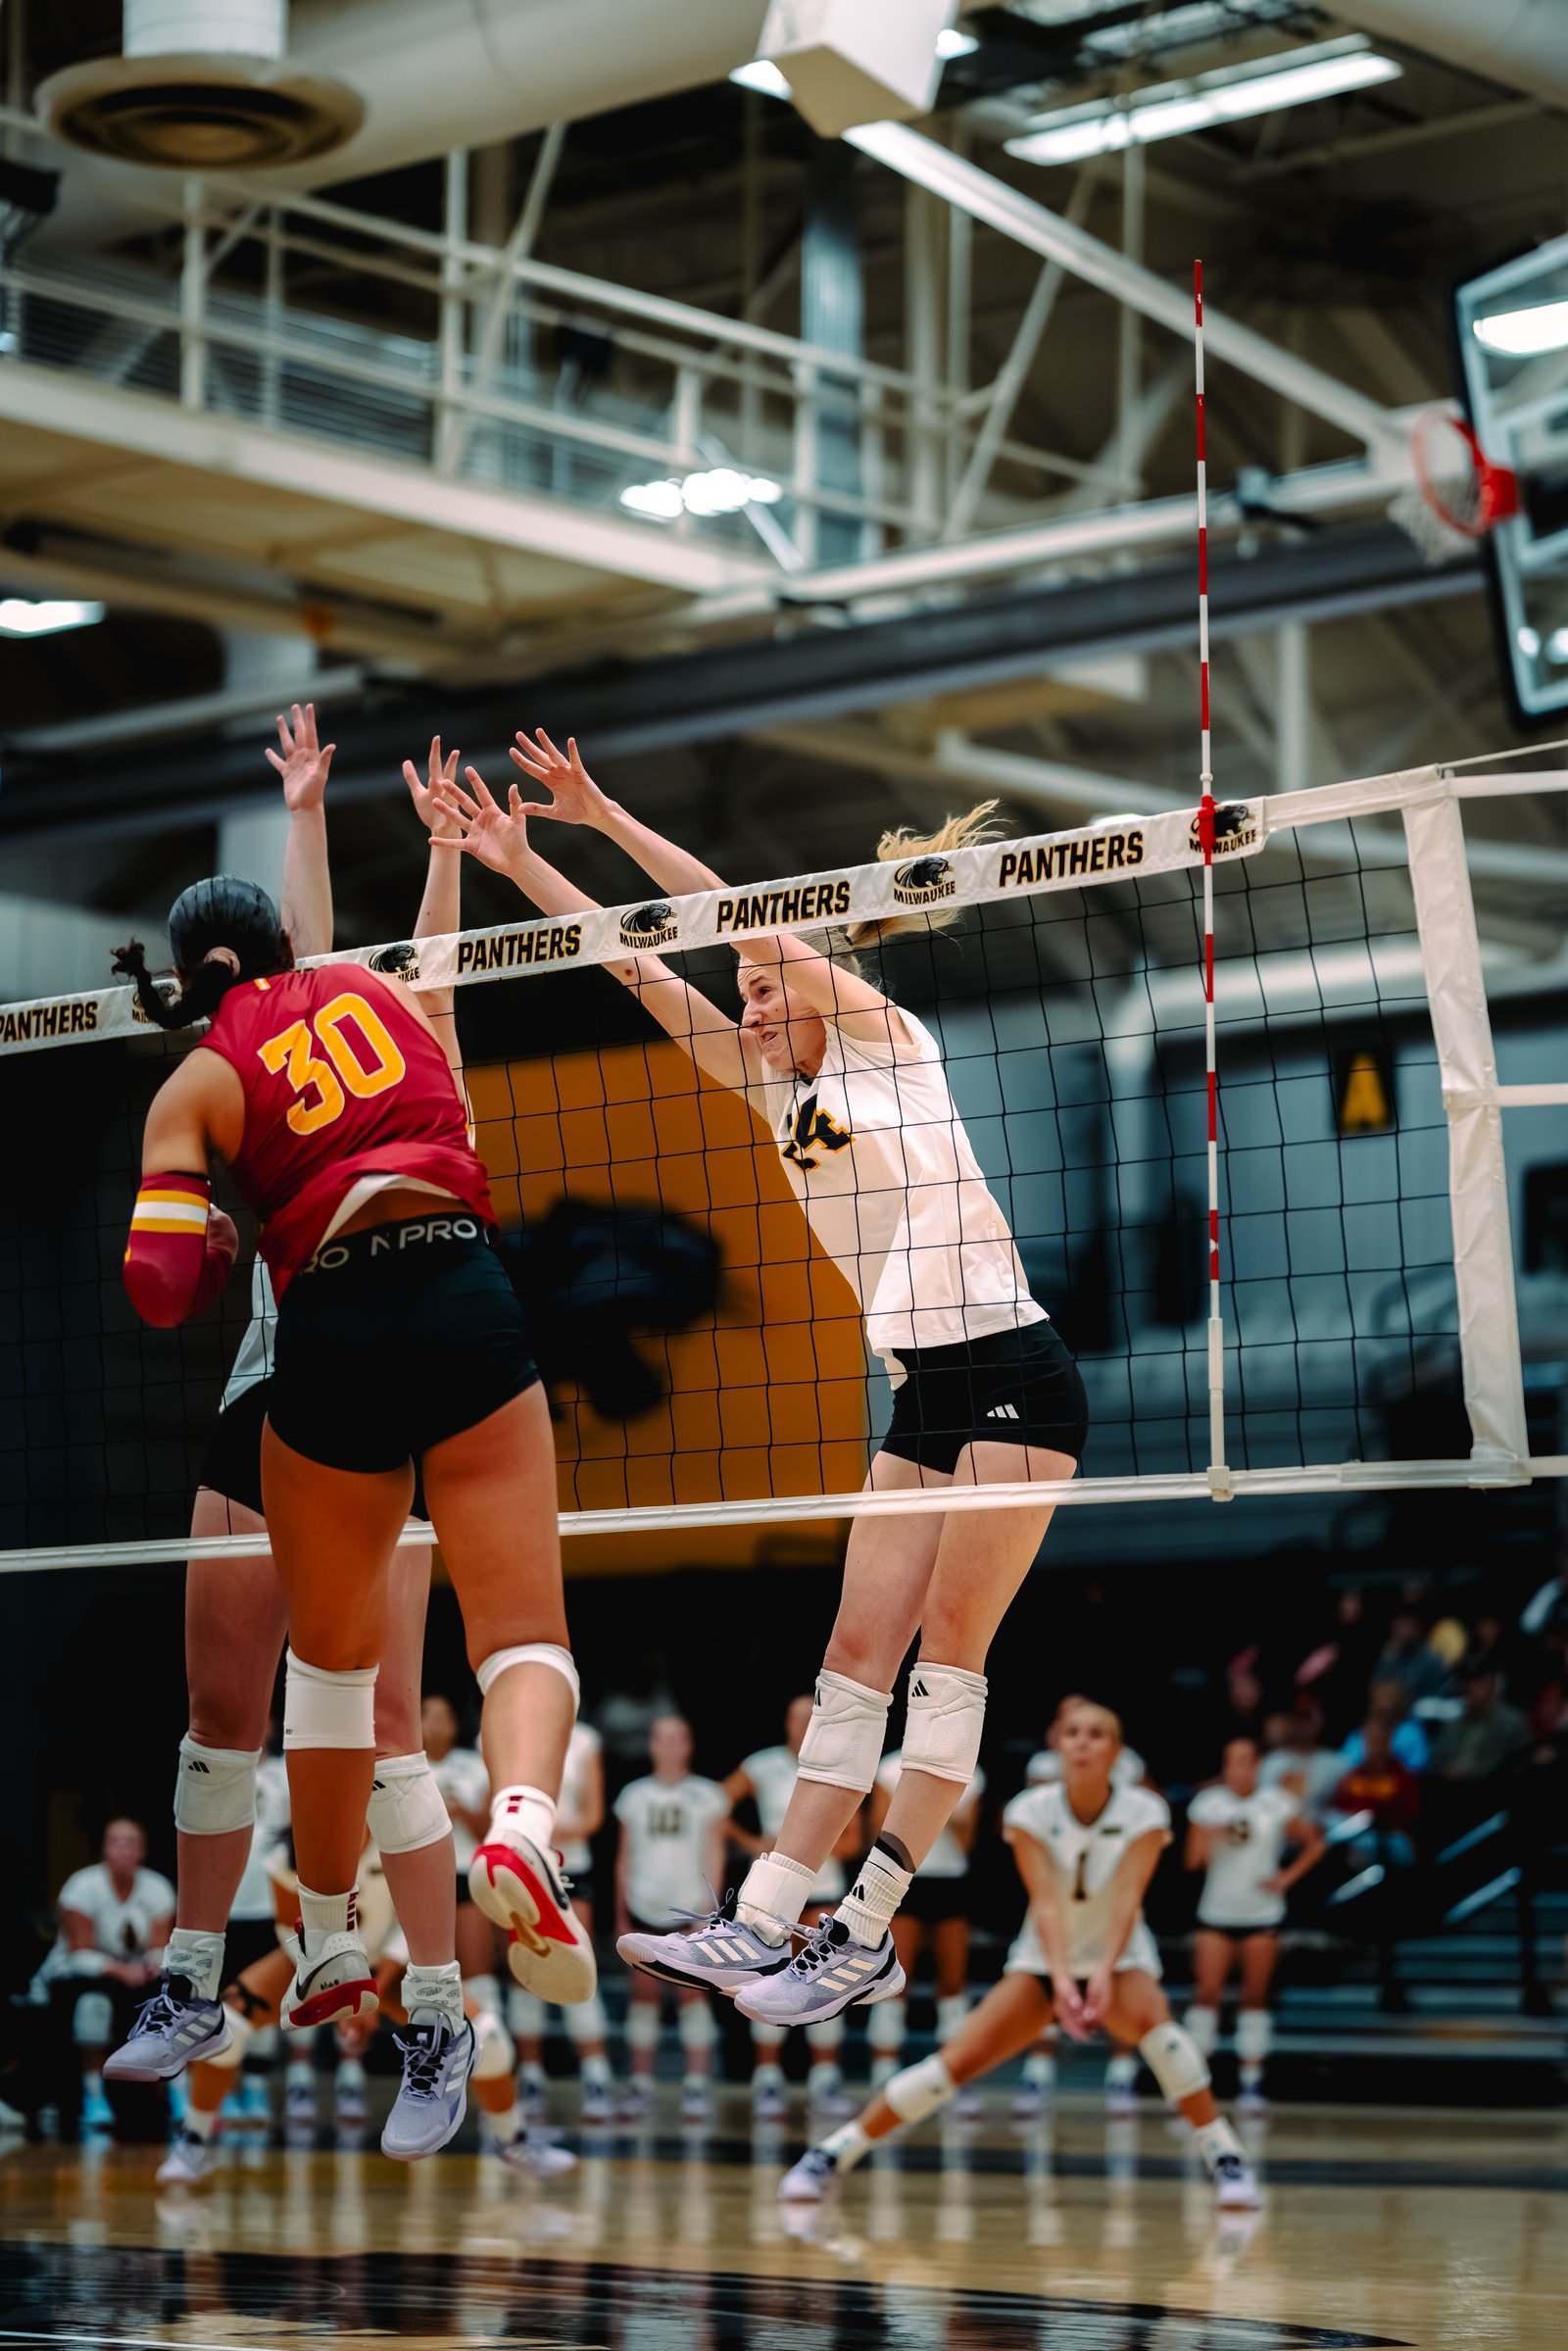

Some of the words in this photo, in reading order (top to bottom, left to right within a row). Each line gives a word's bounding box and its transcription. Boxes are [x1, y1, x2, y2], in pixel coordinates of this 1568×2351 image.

[999, 831, 1145, 888] PANTHERS
[1189, 830, 1256, 854] MWAUKEE
[716, 880, 850, 934] PANTHERS
[894, 880, 956, 906] MILWAUKEE
[457, 924, 582, 975] PANTHERS
[619, 926, 678, 950] MILWAUKEE
[257, 993, 406, 1136] 30
[399, 1219, 477, 1249] PRO
